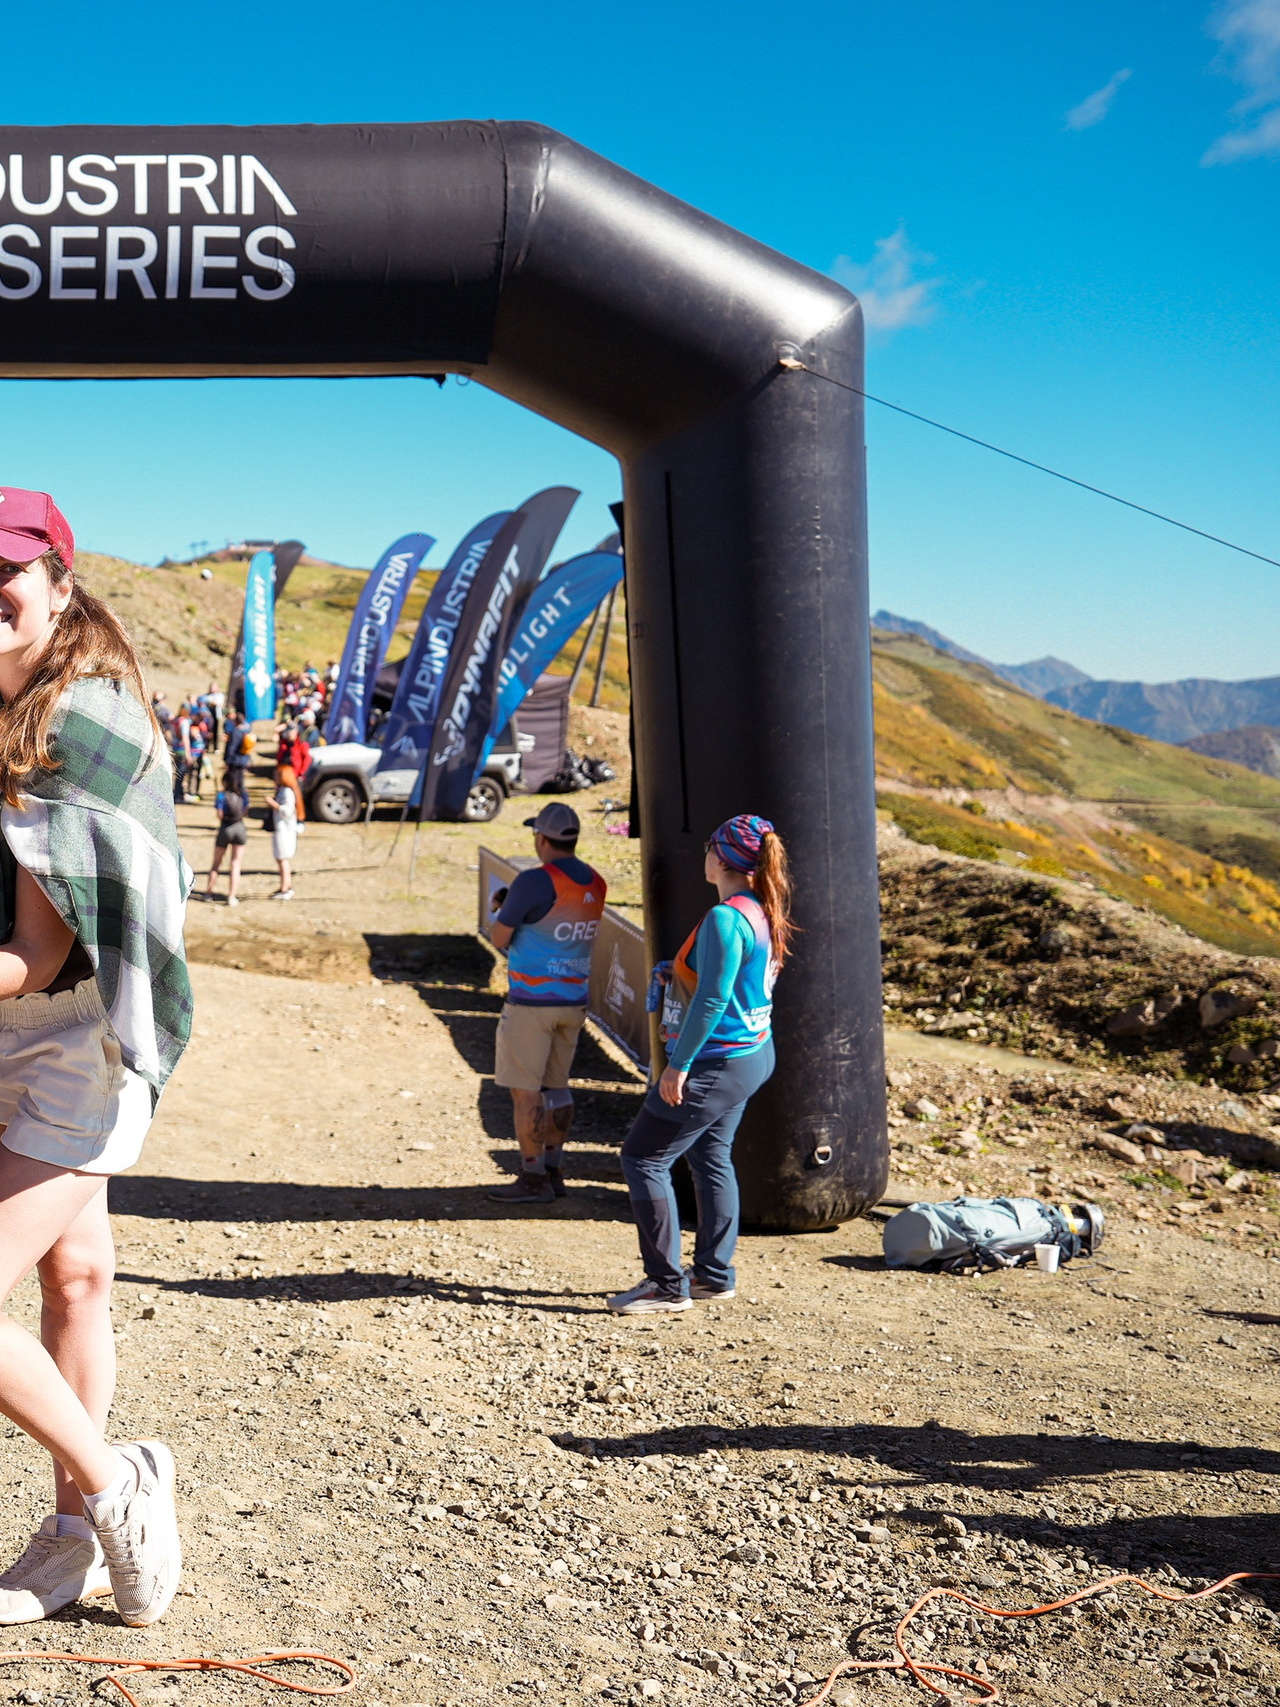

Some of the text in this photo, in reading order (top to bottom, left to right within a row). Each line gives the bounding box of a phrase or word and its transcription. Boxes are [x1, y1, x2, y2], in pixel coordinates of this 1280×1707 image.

[346, 552, 415, 707] ALPINDUSTRIA
[407, 539, 494, 724] ALPINDUSTRIA
[451, 544, 521, 731] DYNAFIT
[497, 585, 572, 694] IDLIGHT
[554, 920, 599, 941] CRE
